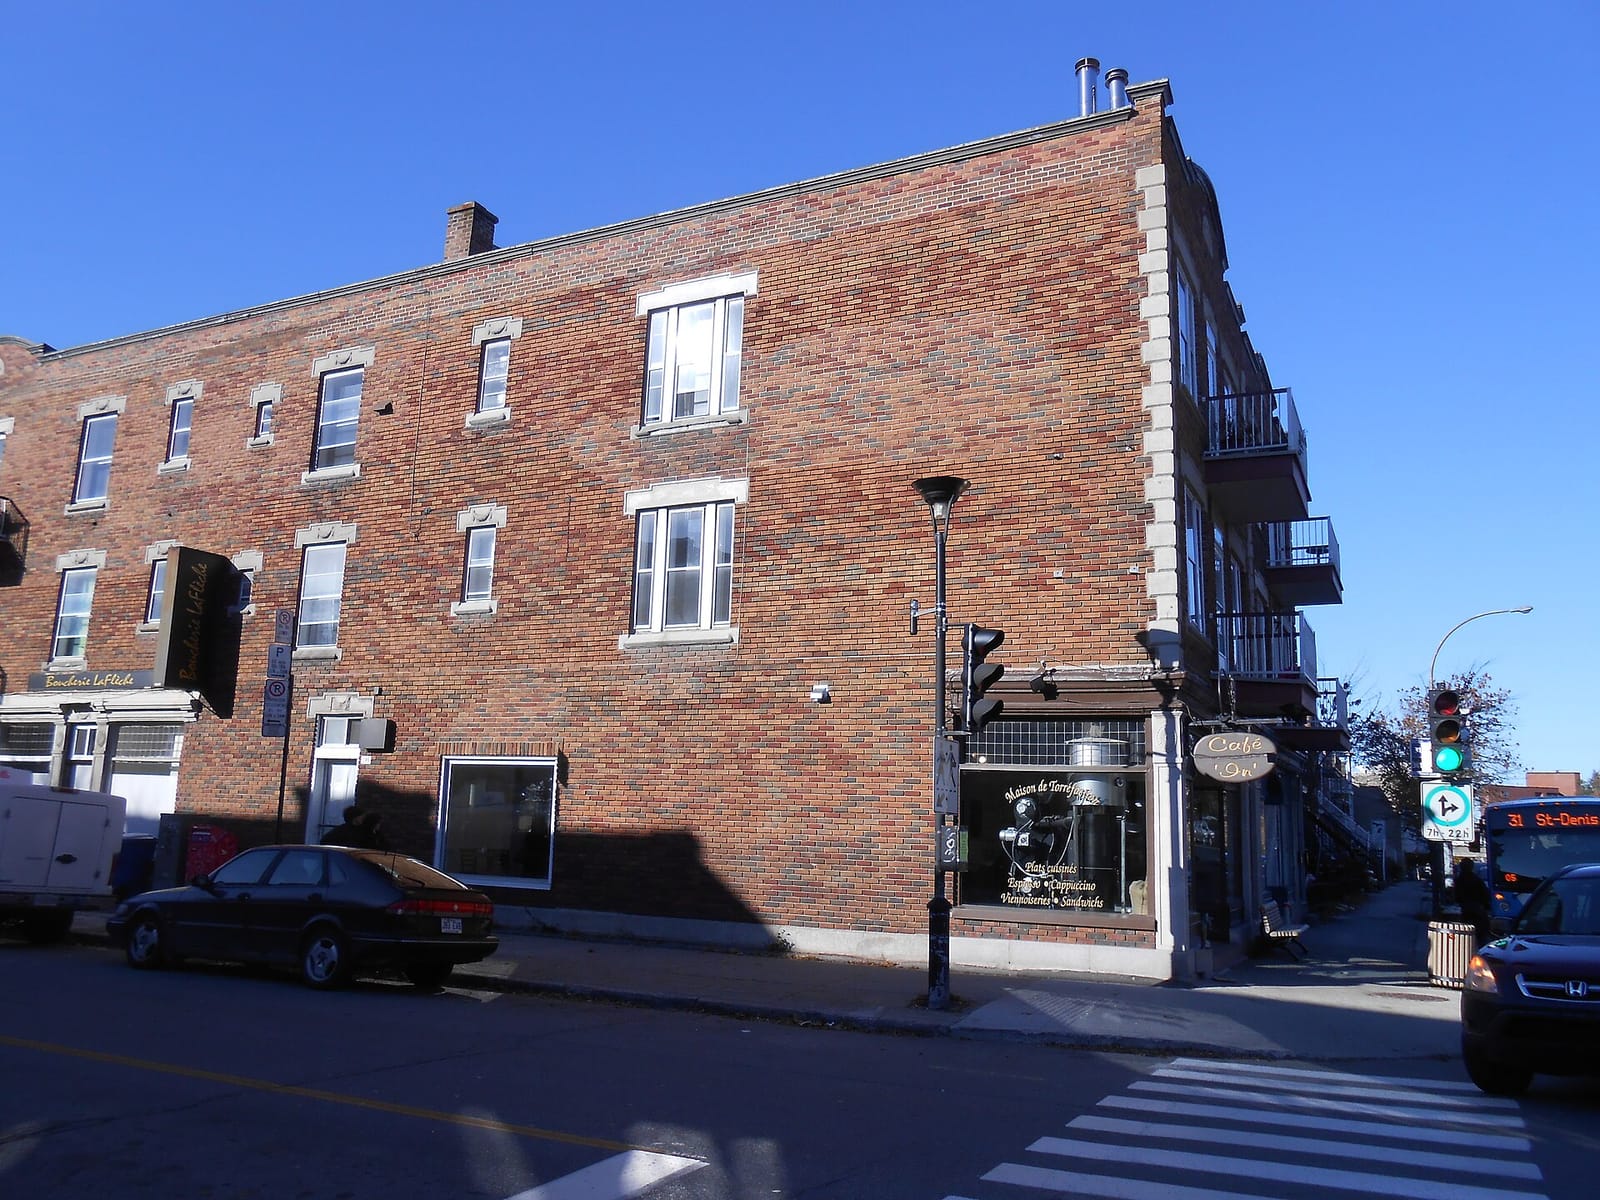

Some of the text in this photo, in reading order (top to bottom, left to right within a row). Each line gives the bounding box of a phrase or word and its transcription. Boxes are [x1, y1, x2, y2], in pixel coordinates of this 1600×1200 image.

[276, 647, 284, 657] P
[45, 675, 91, 688] Boucherie
[1208, 736, 1262, 753] Café
[1005, 785, 1036, 803] Maison
[1038, 779, 1048, 792] de
[1507, 812, 1599, 827] 31 St-Denis
[1448, 829, 1469, 838] 22h
[1025, 861, 1078, 874] Plats cuisinés
[1050, 879, 1096, 894] Cappuccino
[1000, 891, 1104, 908] Viennoiseries Sandwichs
